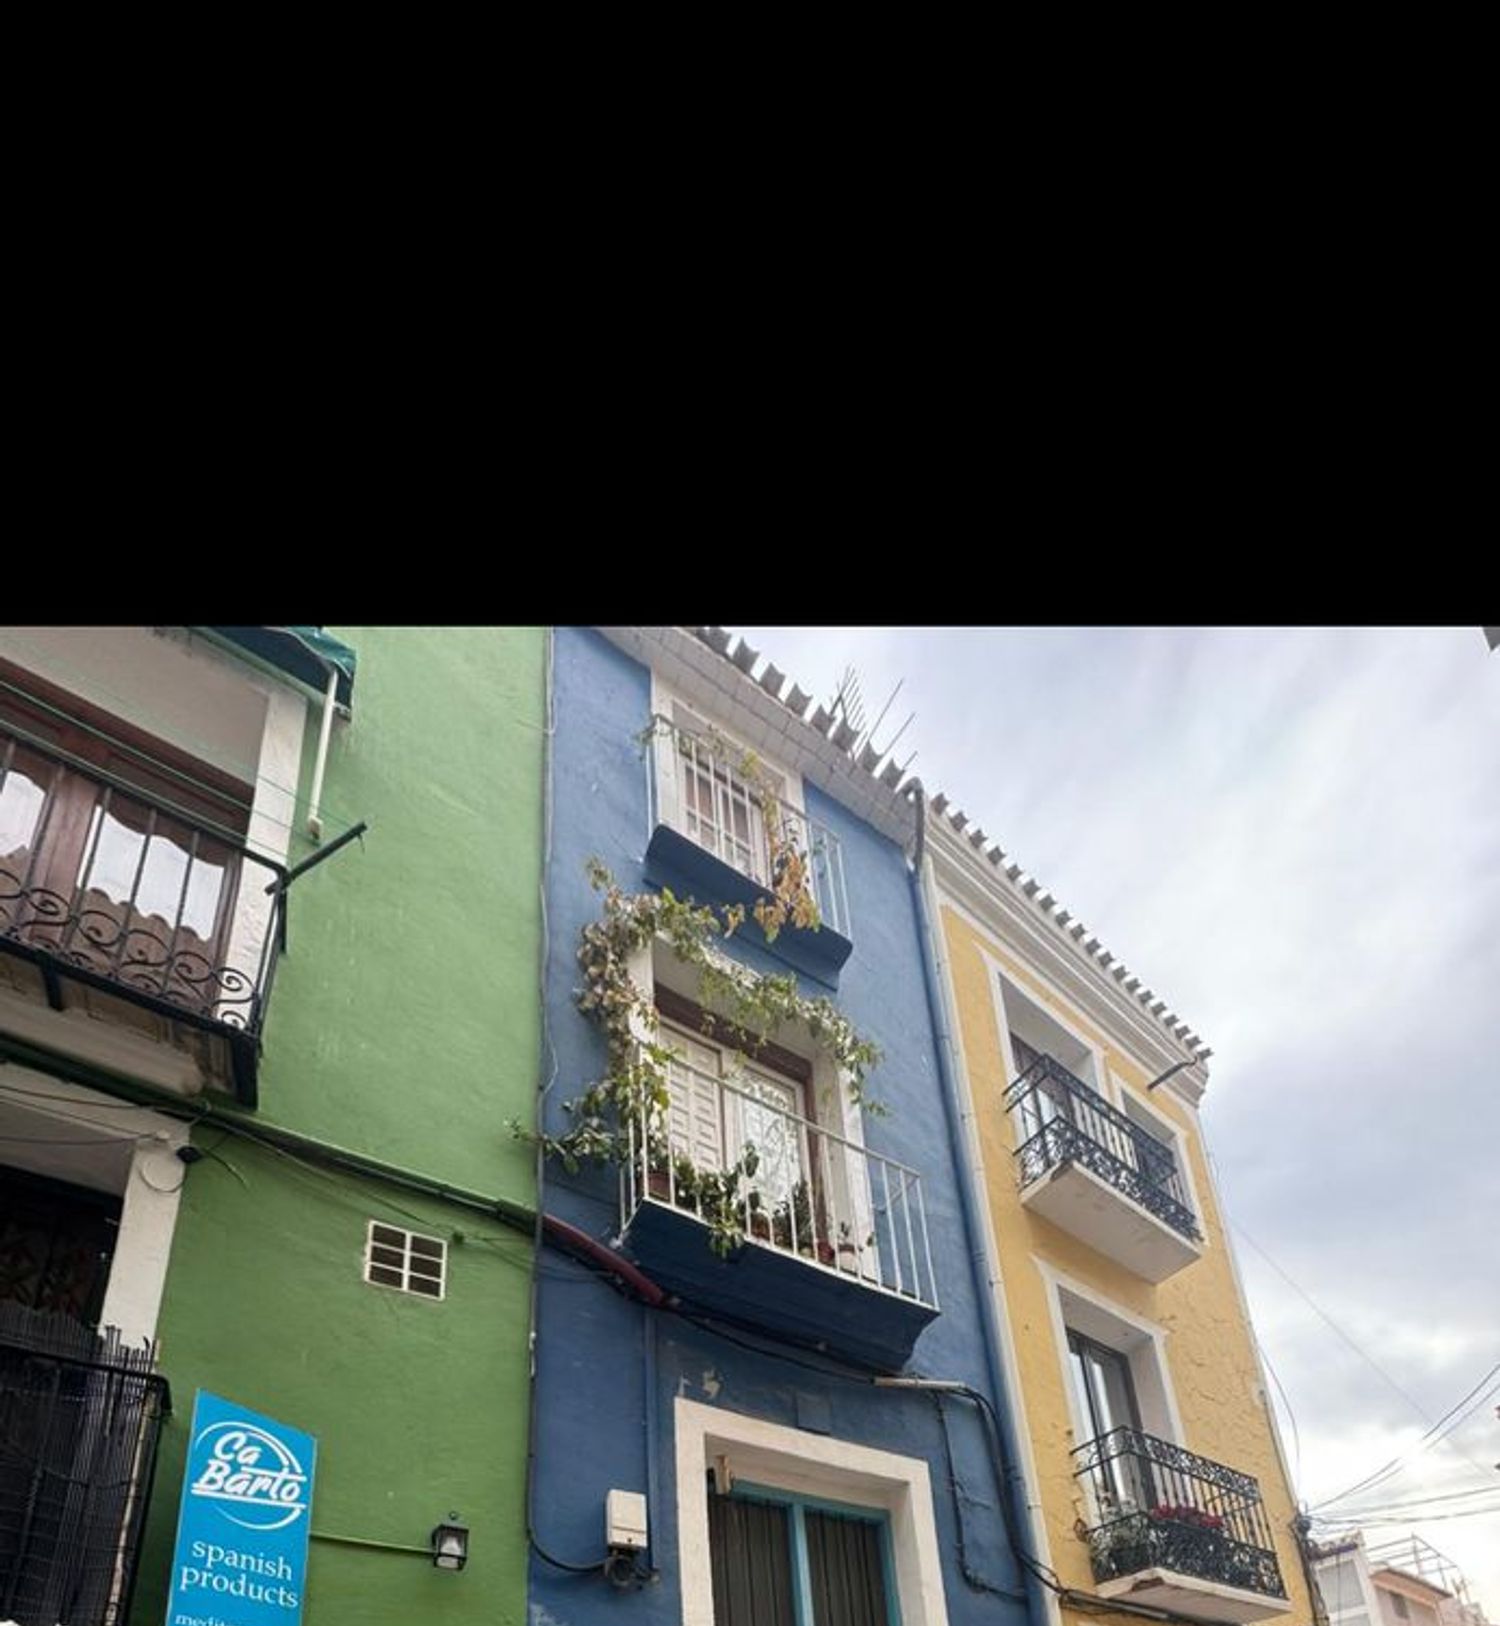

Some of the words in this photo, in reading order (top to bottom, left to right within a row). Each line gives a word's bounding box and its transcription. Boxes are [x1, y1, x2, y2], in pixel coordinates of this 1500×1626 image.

[214, 1431, 262, 1466] Ca
[194, 1459, 305, 1502] Barto
[192, 1539, 292, 1581] spanish
[179, 1564, 298, 1609] products
